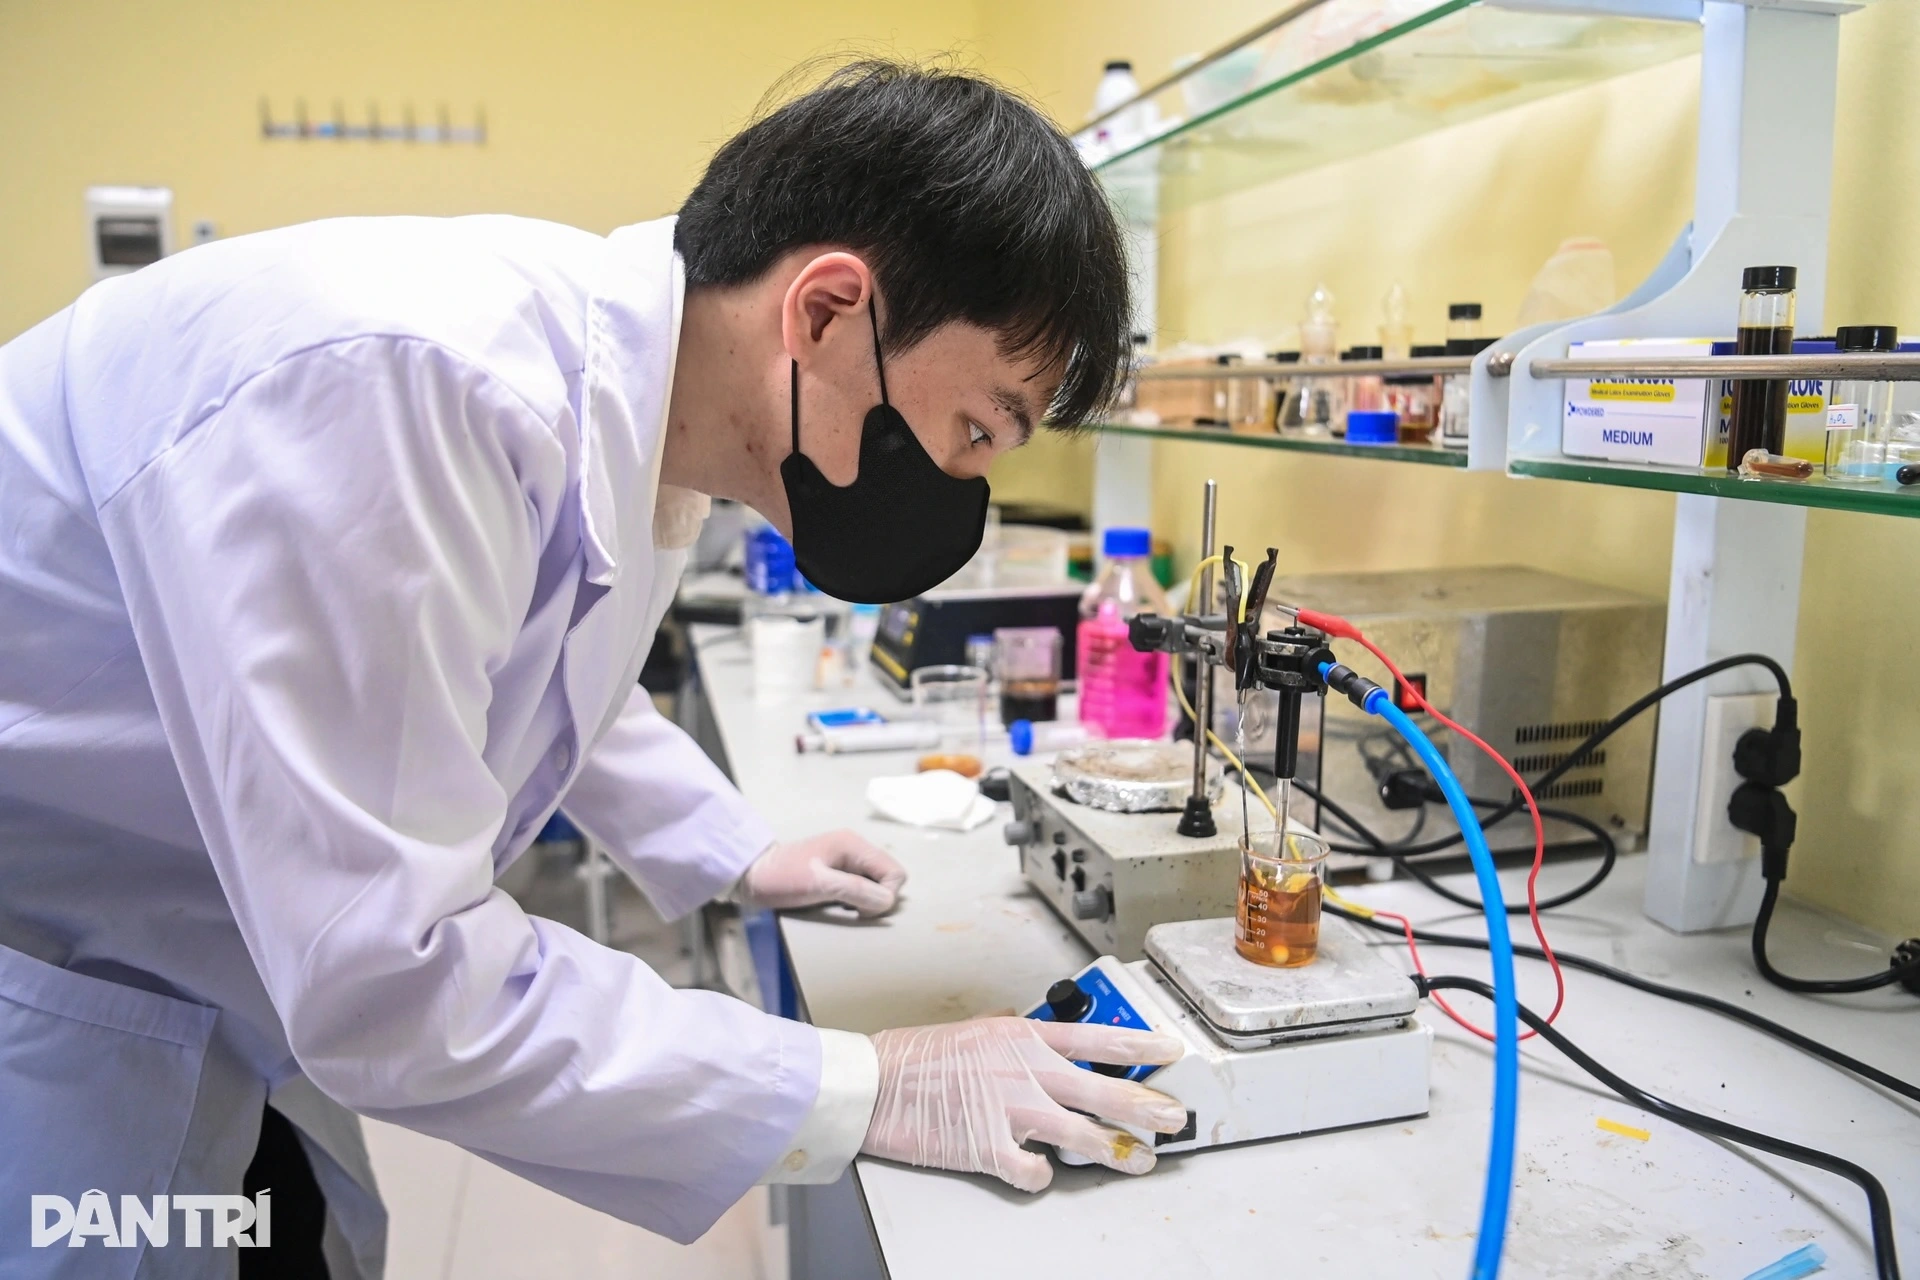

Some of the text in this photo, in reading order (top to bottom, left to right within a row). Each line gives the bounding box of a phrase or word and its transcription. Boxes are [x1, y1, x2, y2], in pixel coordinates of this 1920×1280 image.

[1623, 389, 1653, 397] Examination
[1654, 389, 1671, 398] Gloves
[1788, 379, 1823, 396] LOVE
[1602, 429, 1653, 446] MEDIUM
[1257, 915, 1266, 923] 30
[1117, 1006, 1131, 1021] POWER
